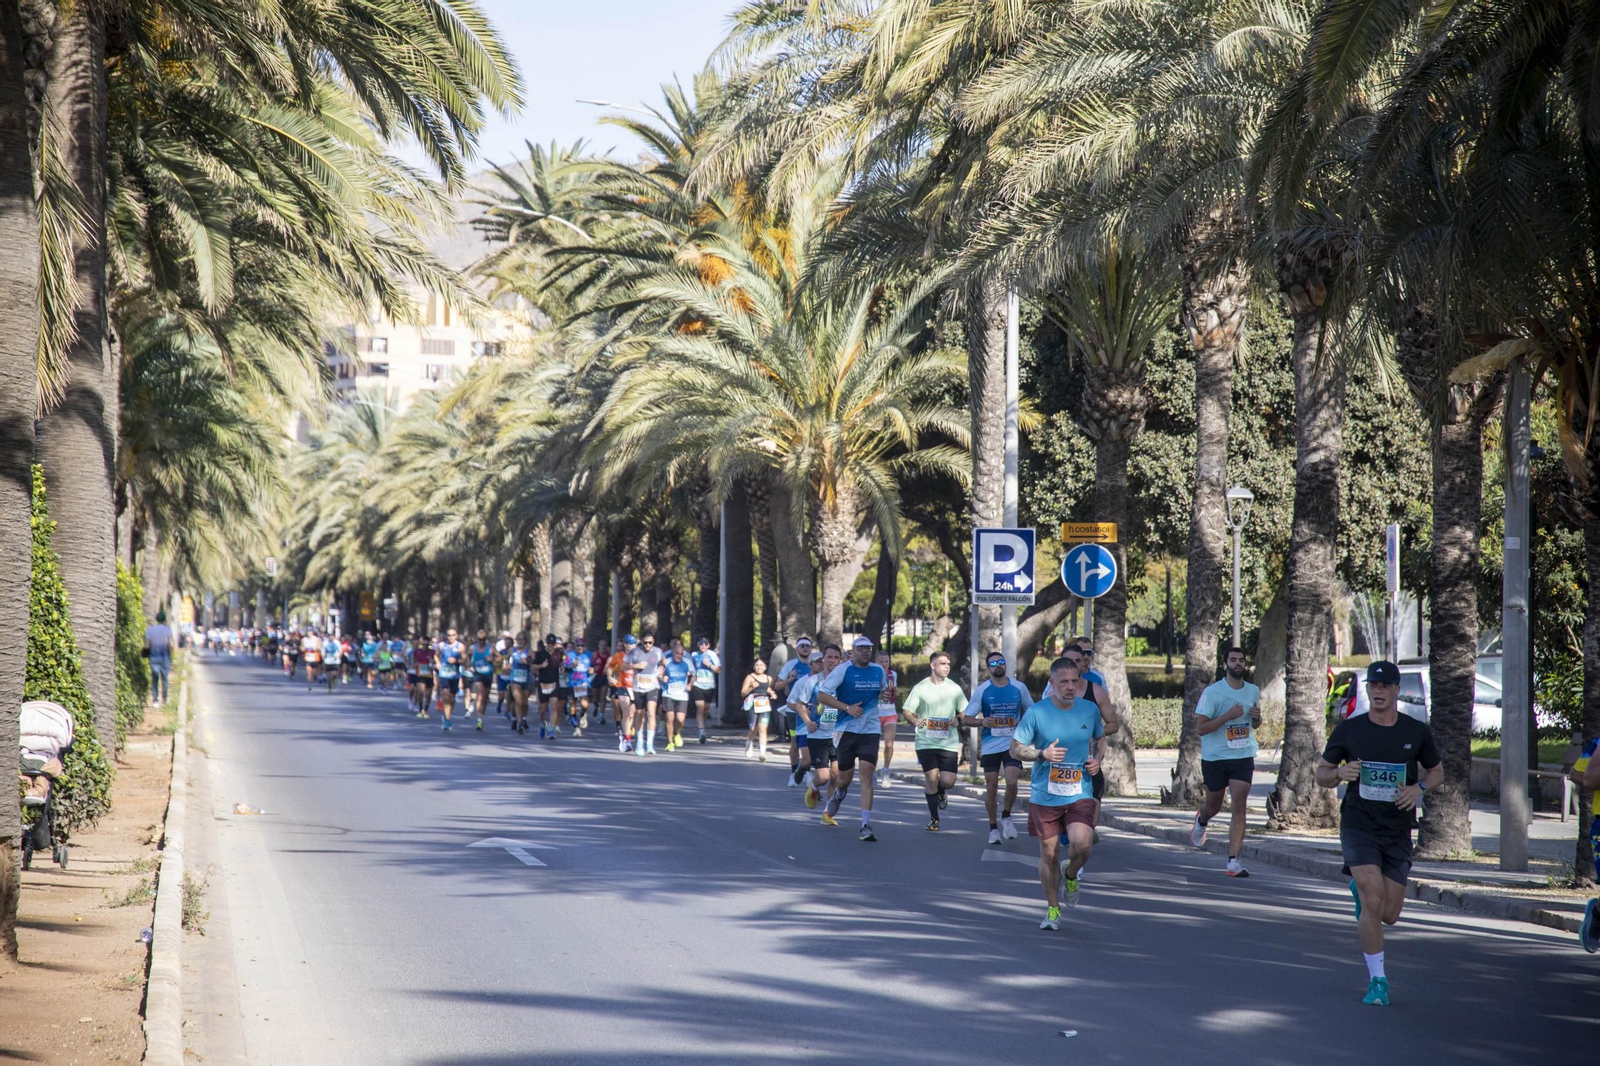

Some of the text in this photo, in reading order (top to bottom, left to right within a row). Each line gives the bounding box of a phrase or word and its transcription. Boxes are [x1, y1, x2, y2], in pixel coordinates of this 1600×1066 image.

[980, 533, 1029, 590] P
[994, 582, 1013, 591] 24h
[1057, 770, 1078, 779] 280
[1370, 770, 1397, 782] 346
